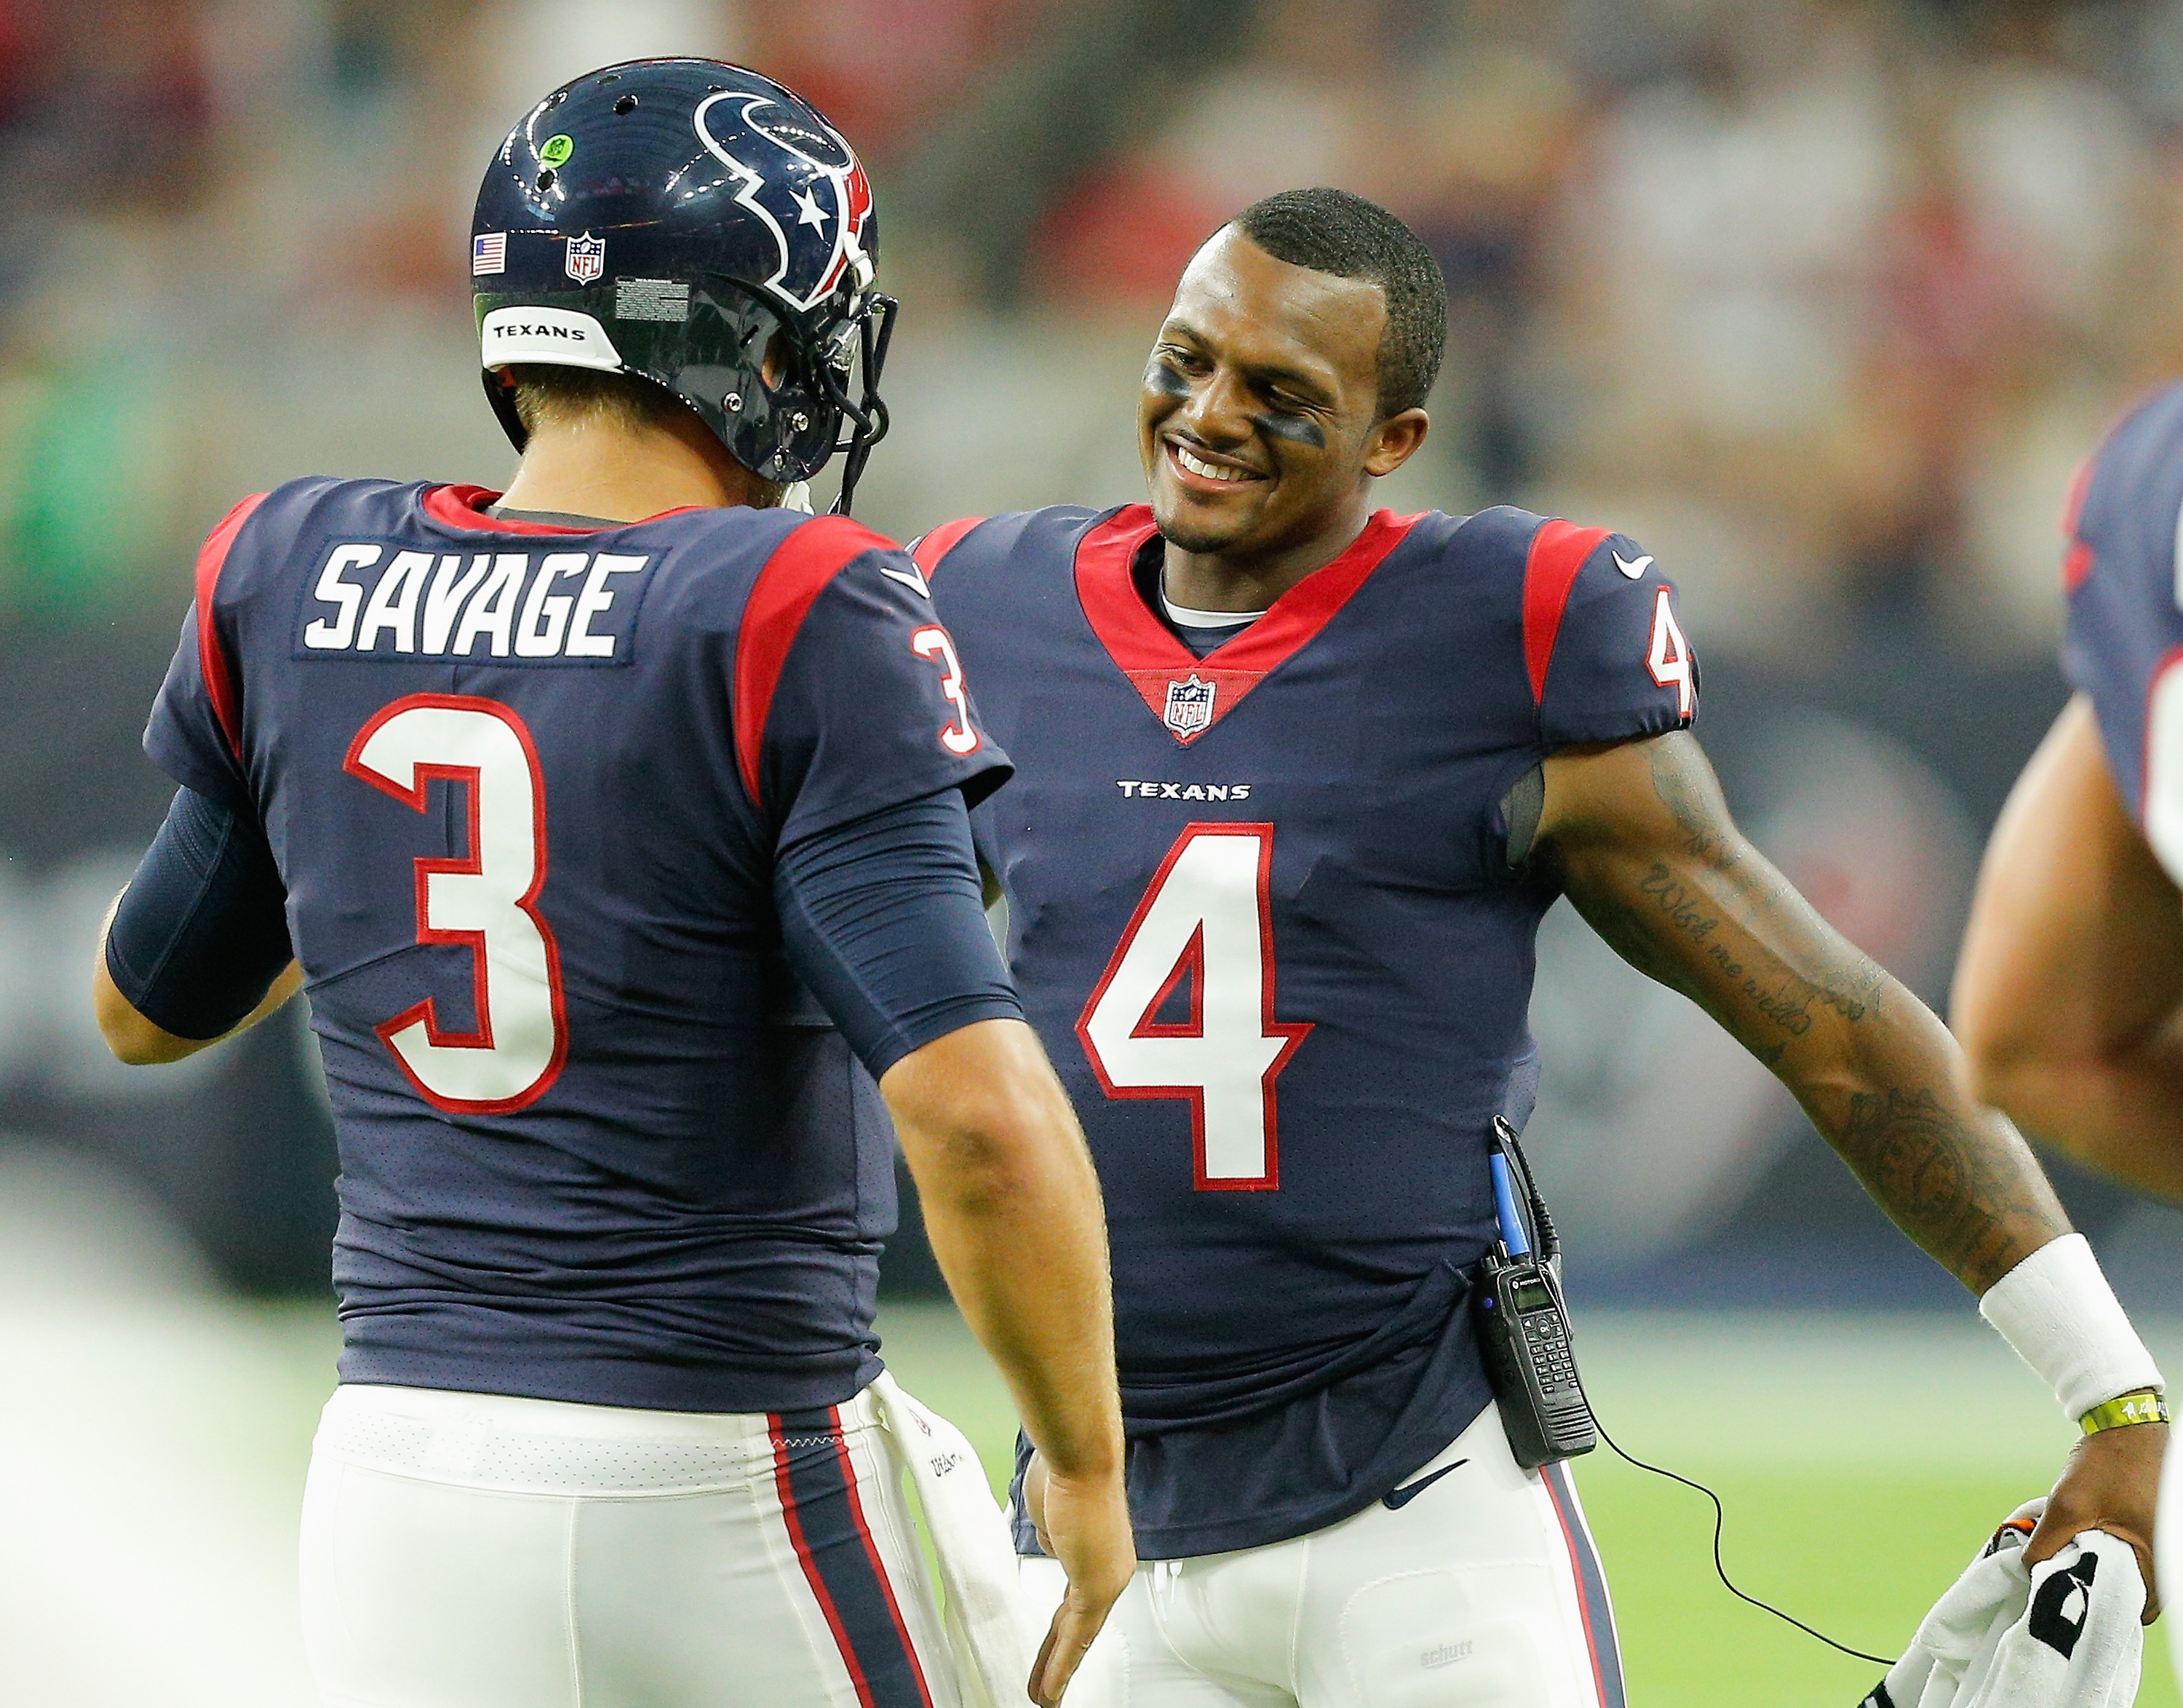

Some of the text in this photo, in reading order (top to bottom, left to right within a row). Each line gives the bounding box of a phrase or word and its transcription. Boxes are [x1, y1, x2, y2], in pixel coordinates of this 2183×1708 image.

[572, 256, 599, 275] NFL
[493, 325, 586, 341] TEXANS
[303, 543, 650, 658] SAVAGE
[1645, 584, 1694, 718] 4
[910, 623, 982, 757] 3
[1171, 702, 1206, 726] NFL
[1116, 779, 1252, 802] TEXANS
[342, 691, 570, 1115] 3
[1073, 822, 1316, 1191] 4
[1420, 1639, 1474, 1667] schutt
